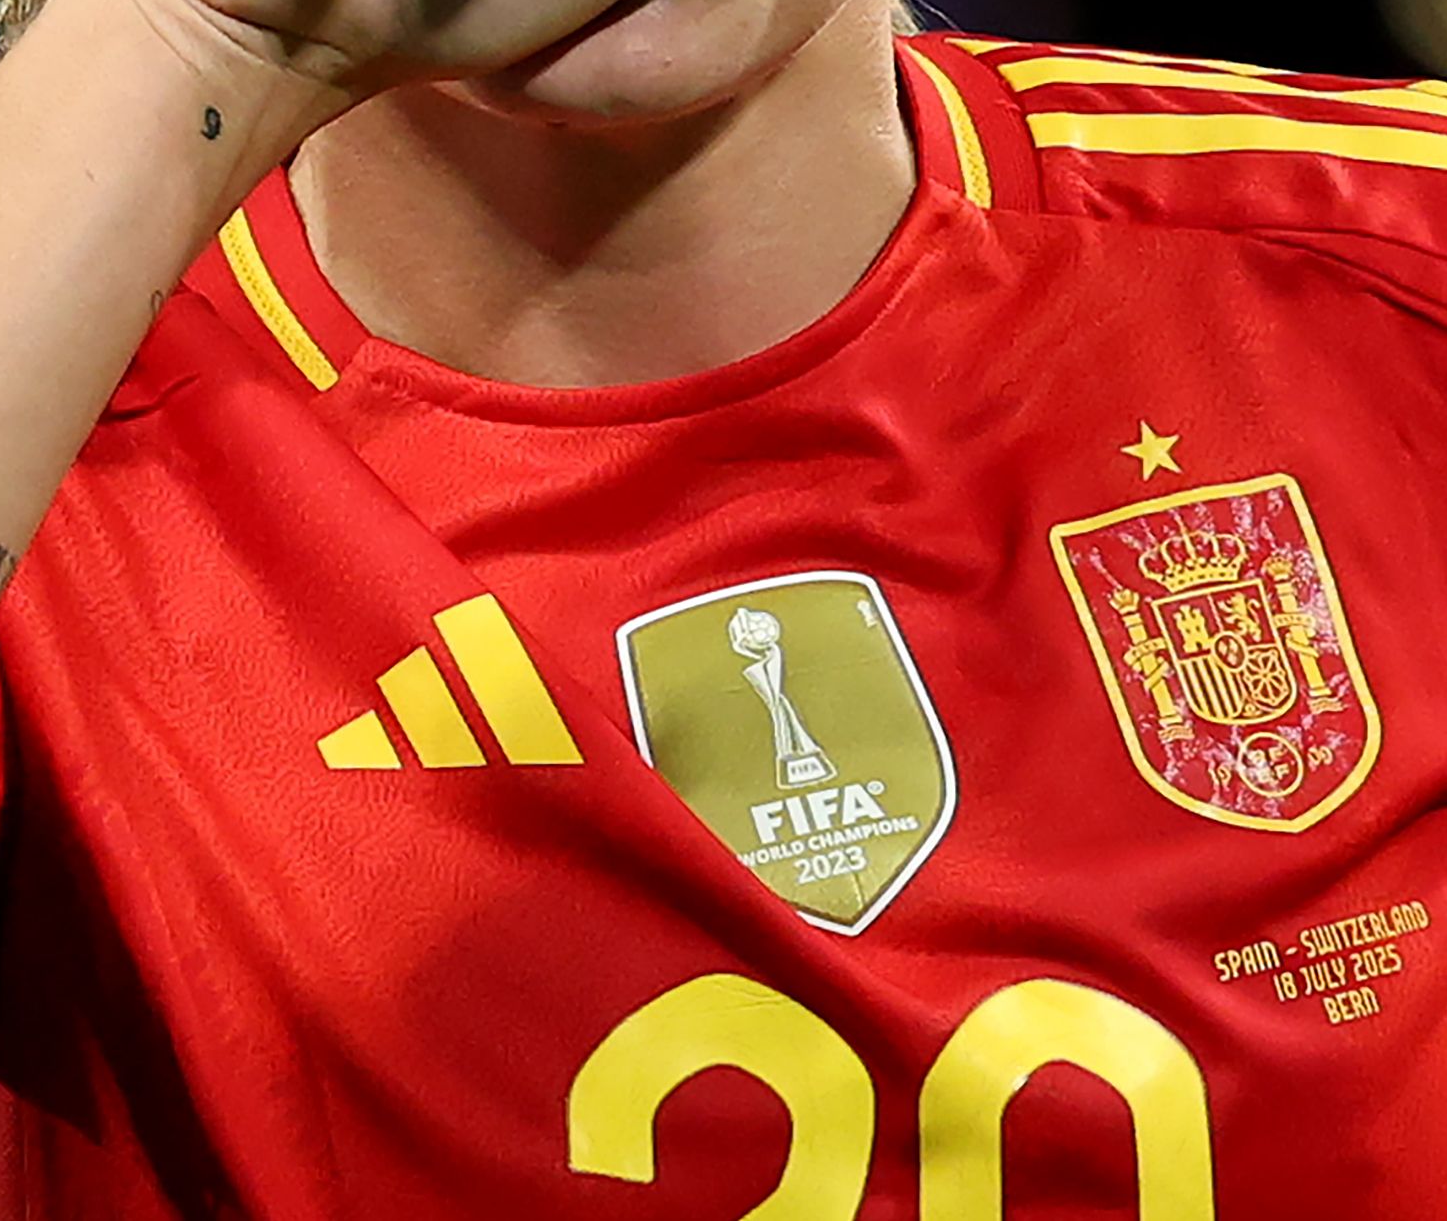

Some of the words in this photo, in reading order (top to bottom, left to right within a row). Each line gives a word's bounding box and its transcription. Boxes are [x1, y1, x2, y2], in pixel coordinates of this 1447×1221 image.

[736, 840, 805, 867] WORLD
[807, 815, 920, 851] CHAMPIONS
[794, 845, 868, 885] 2023
[1213, 940, 1281, 983] SPAIN
[1299, 900, 1430, 960] SWITZERLAND
[1272, 971, 1299, 1003] 18
[1298, 956, 1347, 996] JULY
[1349, 943, 1403, 982] 2025
[1322, 986, 1381, 1025] BERN
